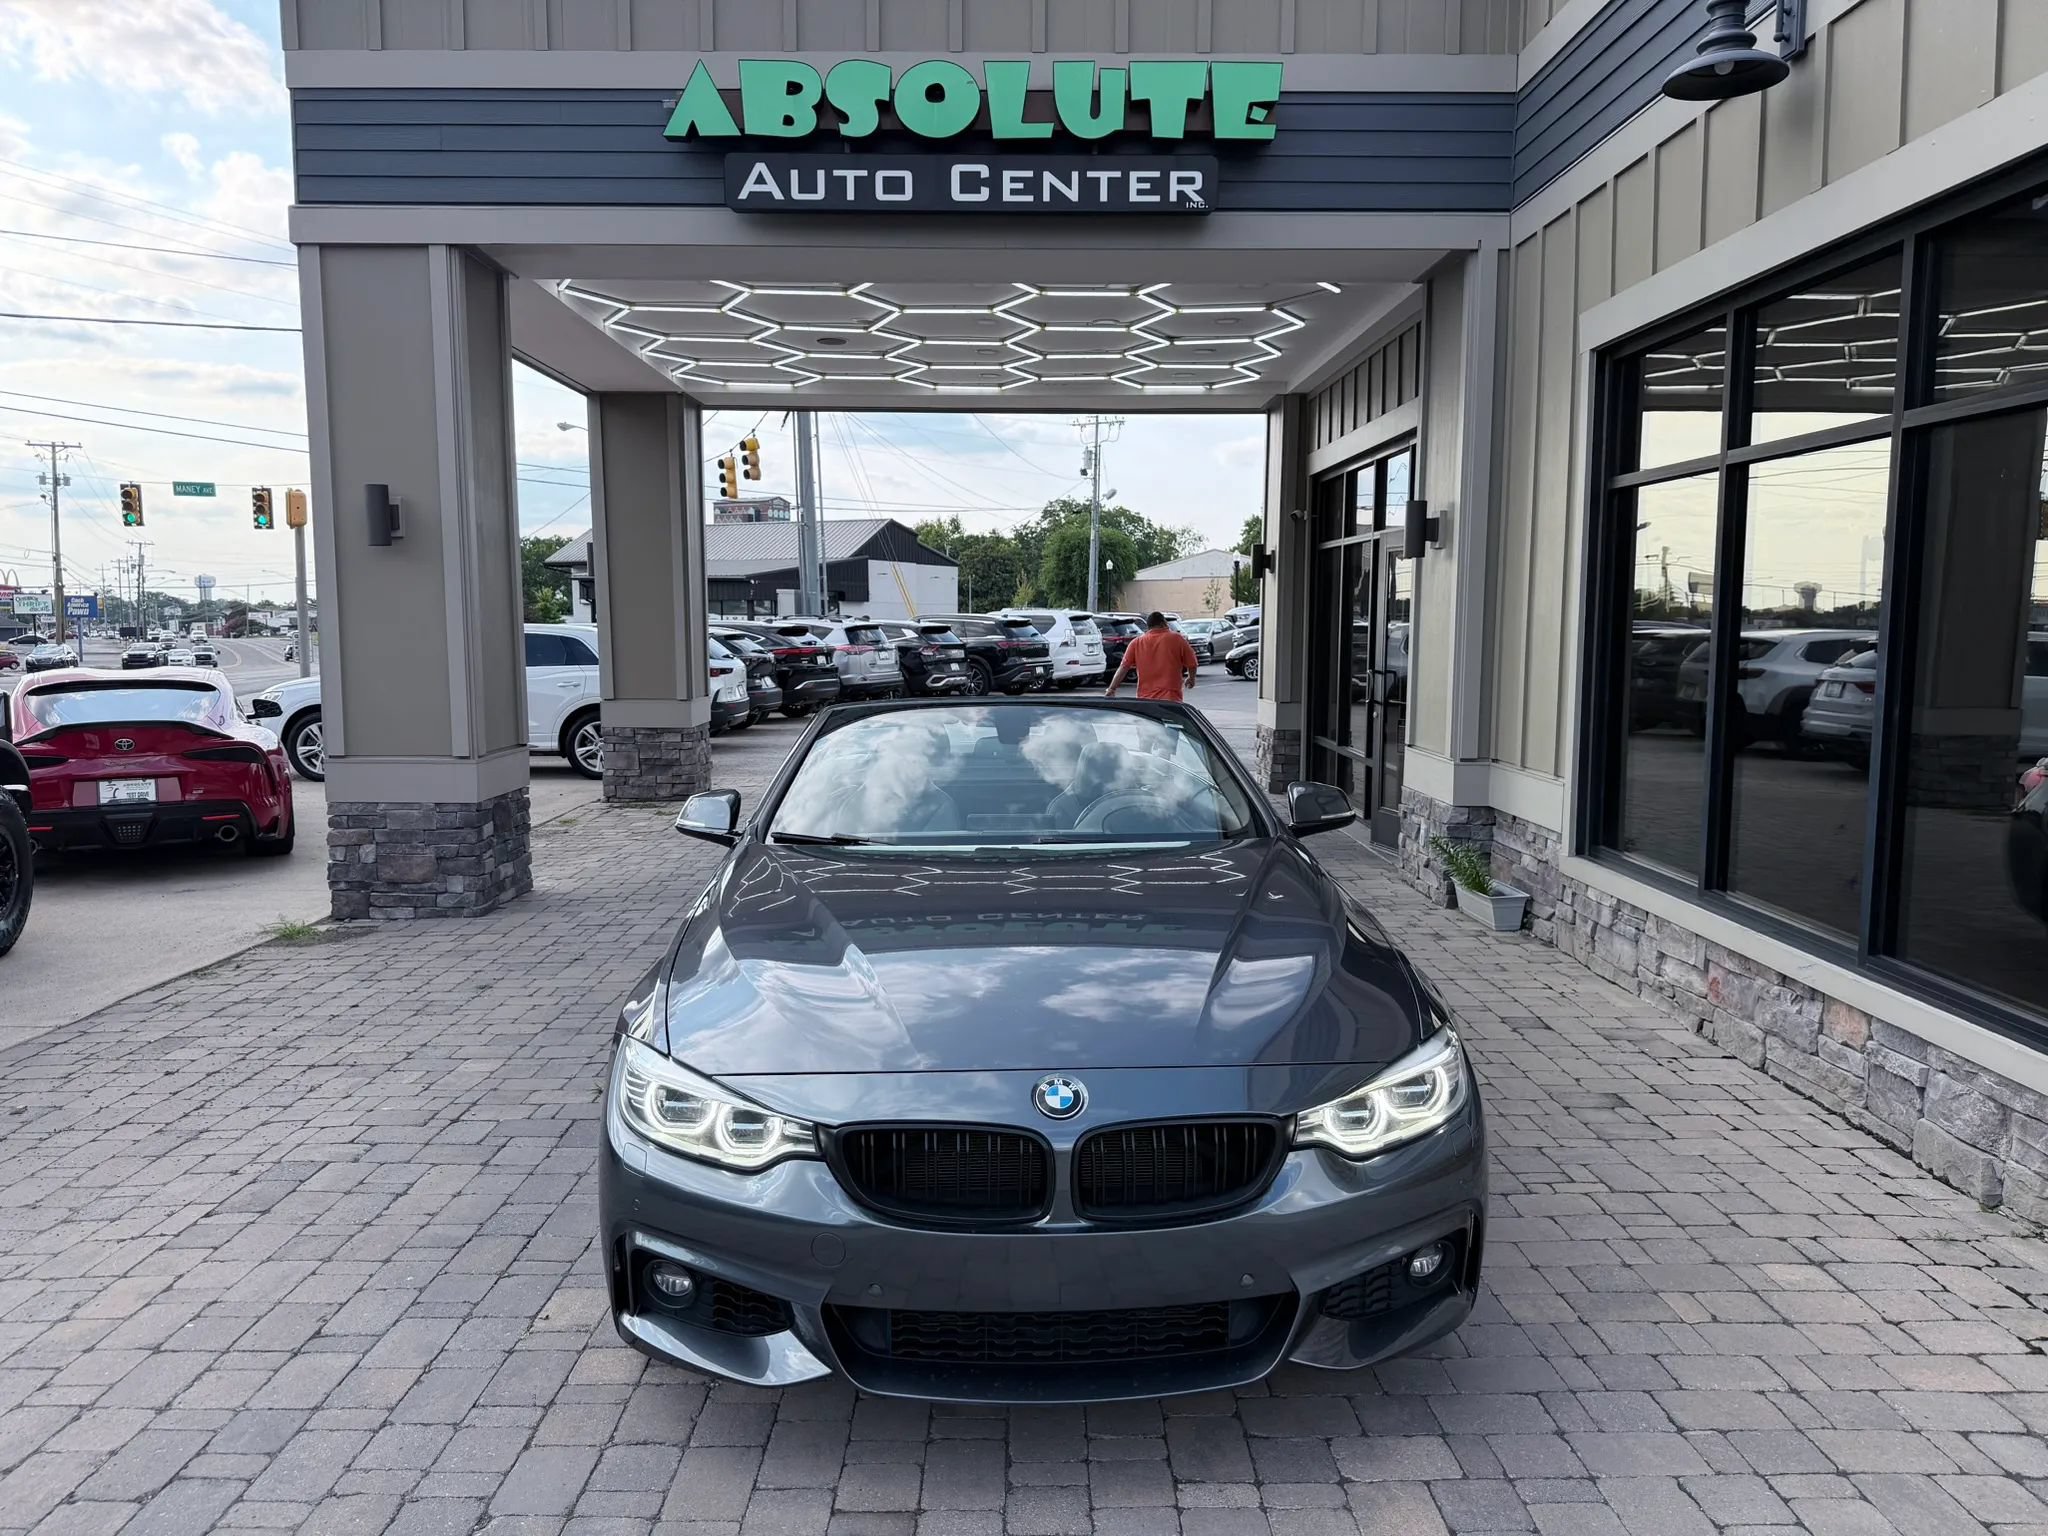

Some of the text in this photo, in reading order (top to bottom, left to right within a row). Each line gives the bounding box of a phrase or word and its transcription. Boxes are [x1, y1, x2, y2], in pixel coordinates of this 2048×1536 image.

[662, 59, 1284, 141] ABSOLUTE
[737, 162, 1205, 203] AUTO CENTER
[1185, 200, 1209, 209] INC.
[175, 484, 201, 494] MANEY
[1040, 1079, 1078, 1091] BMW
